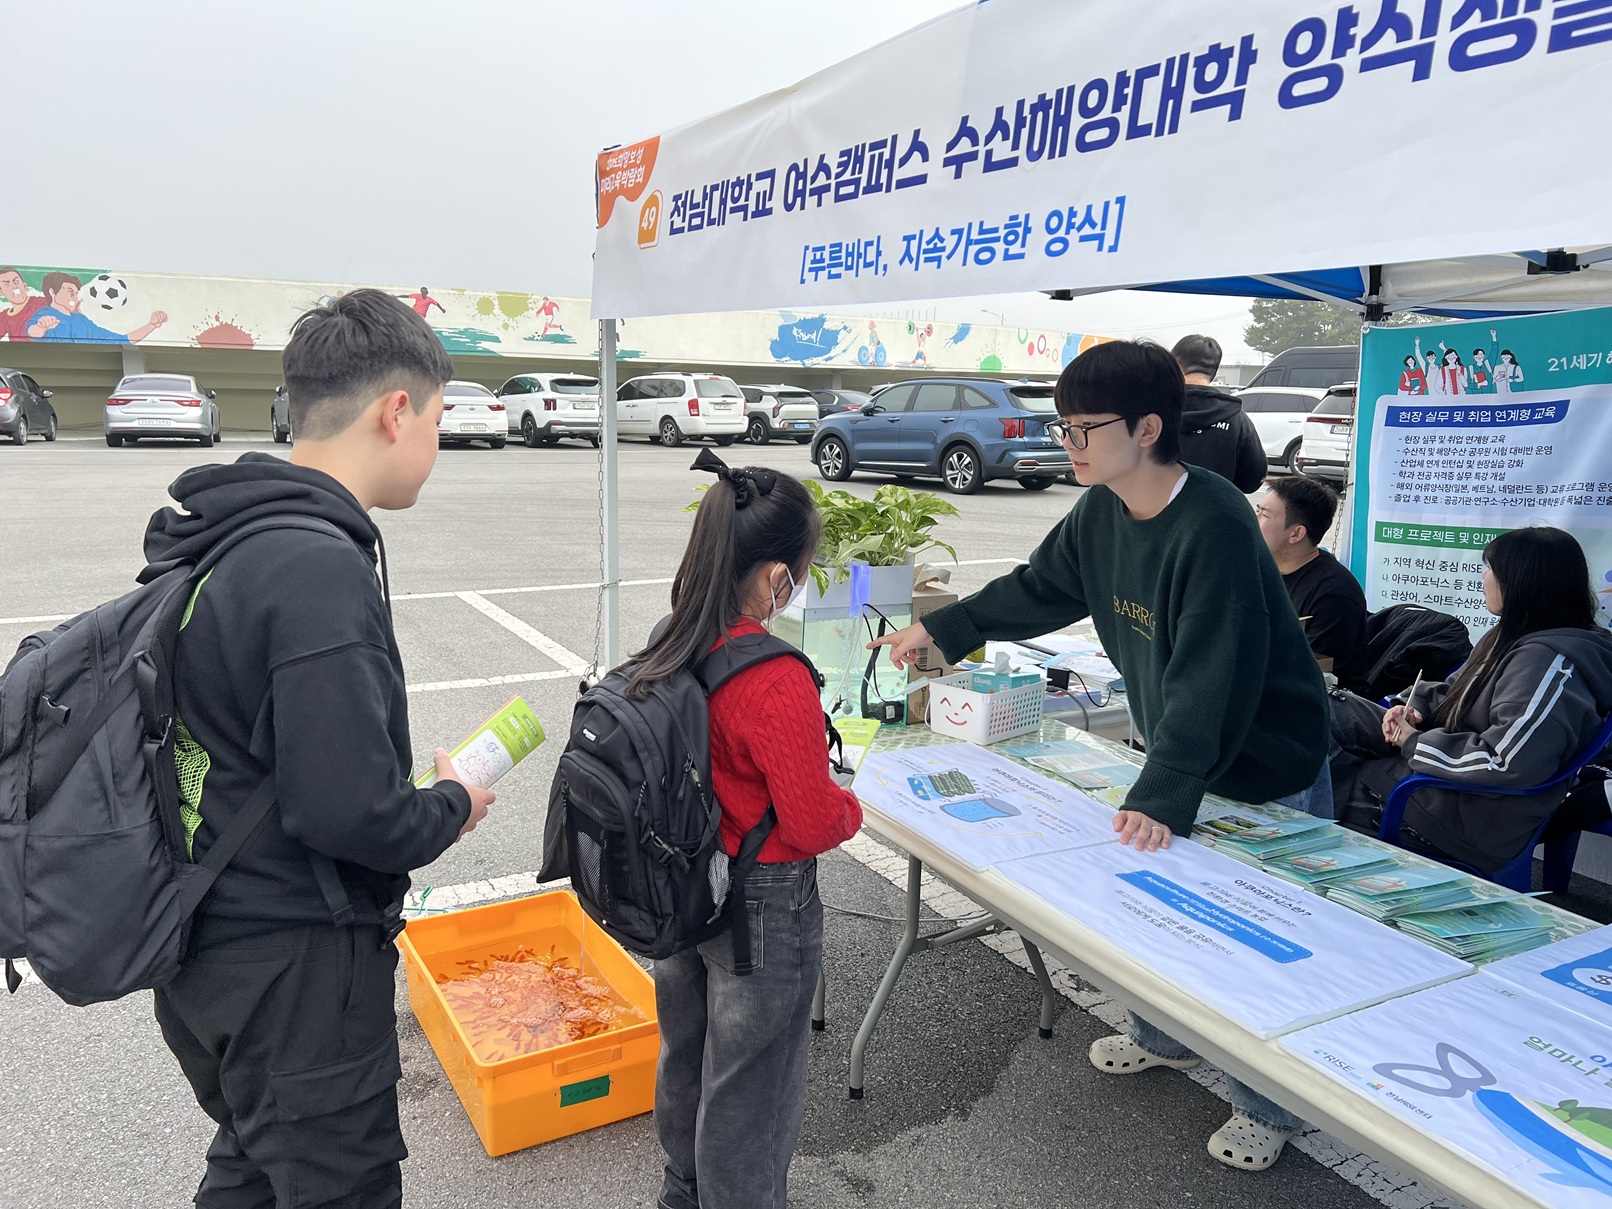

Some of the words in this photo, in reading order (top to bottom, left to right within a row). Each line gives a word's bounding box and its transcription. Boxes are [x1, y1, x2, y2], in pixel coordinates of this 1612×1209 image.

[668, 167, 775, 236] 전남대학교
[783, 135, 930, 214] 여수캠퍼스
[942, 33, 1258, 180] 수산해양대학
[641, 206, 657, 231] 49
[799, 234, 889, 285] [푸른바다,
[899, 212, 1033, 273] 지속가능한
[1043, 195, 1127, 257] 양식]
[1547, 352, 1603, 371] 21세기
[1399, 411, 1422, 423] 현장
[1425, 411, 1449, 422] 실무
[1453, 411, 1465, 423] 및
[1468, 410, 1491, 422] 취업
[1495, 409, 1531, 422] 연계형
[1533, 406, 1556, 420] 교육
[1404, 435, 1420, 445] 현장
[1422, 435, 1437, 445] 실무
[1438, 435, 1446, 445] 및
[1447, 435, 1464, 445] 취업
[1466, 434, 1489, 445] 연계형
[1490, 434, 1506, 444] 교육
[1402, 447, 1426, 456] 수산직
[1428, 447, 1435, 457] 및
[1469, 446, 1491, 456] 공무원
[1493, 446, 1508, 456] 시험
[1509, 446, 1533, 456] 대비반
[1535, 445, 1553, 456] 운영
[1400, 458, 1424, 468] 산업체
[1426, 459, 1439, 468] 연계
[1442, 459, 1464, 469] 인턴십
[1466, 459, 1475, 469] 및
[1507, 458, 1524, 469] 강화
[1398, 470, 1415, 480] 학과
[1416, 471, 1432, 480] 전공
[1433, 471, 1455, 481] 자격증
[1456, 471, 1472, 481] 실무
[1474, 471, 1488, 481] 특강
[1489, 471, 1506, 481] 개설
[1396, 482, 1413, 491] 해외
[1471, 484, 1496, 494] 베트남,
[1498, 484, 1533, 494] 네덜란드
[1535, 484, 1549, 495] 등)
[1394, 493, 1411, 503] 졸업
[1412, 494, 1421, 503] 후
[1423, 495, 1438, 504] 진로
[1382, 527, 1403, 539] 대형
[1406, 528, 1455, 543] 프로젝트
[1459, 532, 1469, 544] 및
[1393, 557, 1411, 568] 지역
[1414, 558, 1435, 571] 혁신
[1438, 560, 1459, 573] 중심
[1461, 563, 1483, 574] RISE
[1392, 573, 1450, 588] 아쿠아포닉스
[1453, 579, 1463, 590] 등
[1390, 589, 1421, 603] 관상어,
[1473, 616, 1488, 628] 인재
[1323, 1054, 1355, 1073] RISE
[1523, 1036, 1601, 1077] 얼마나
